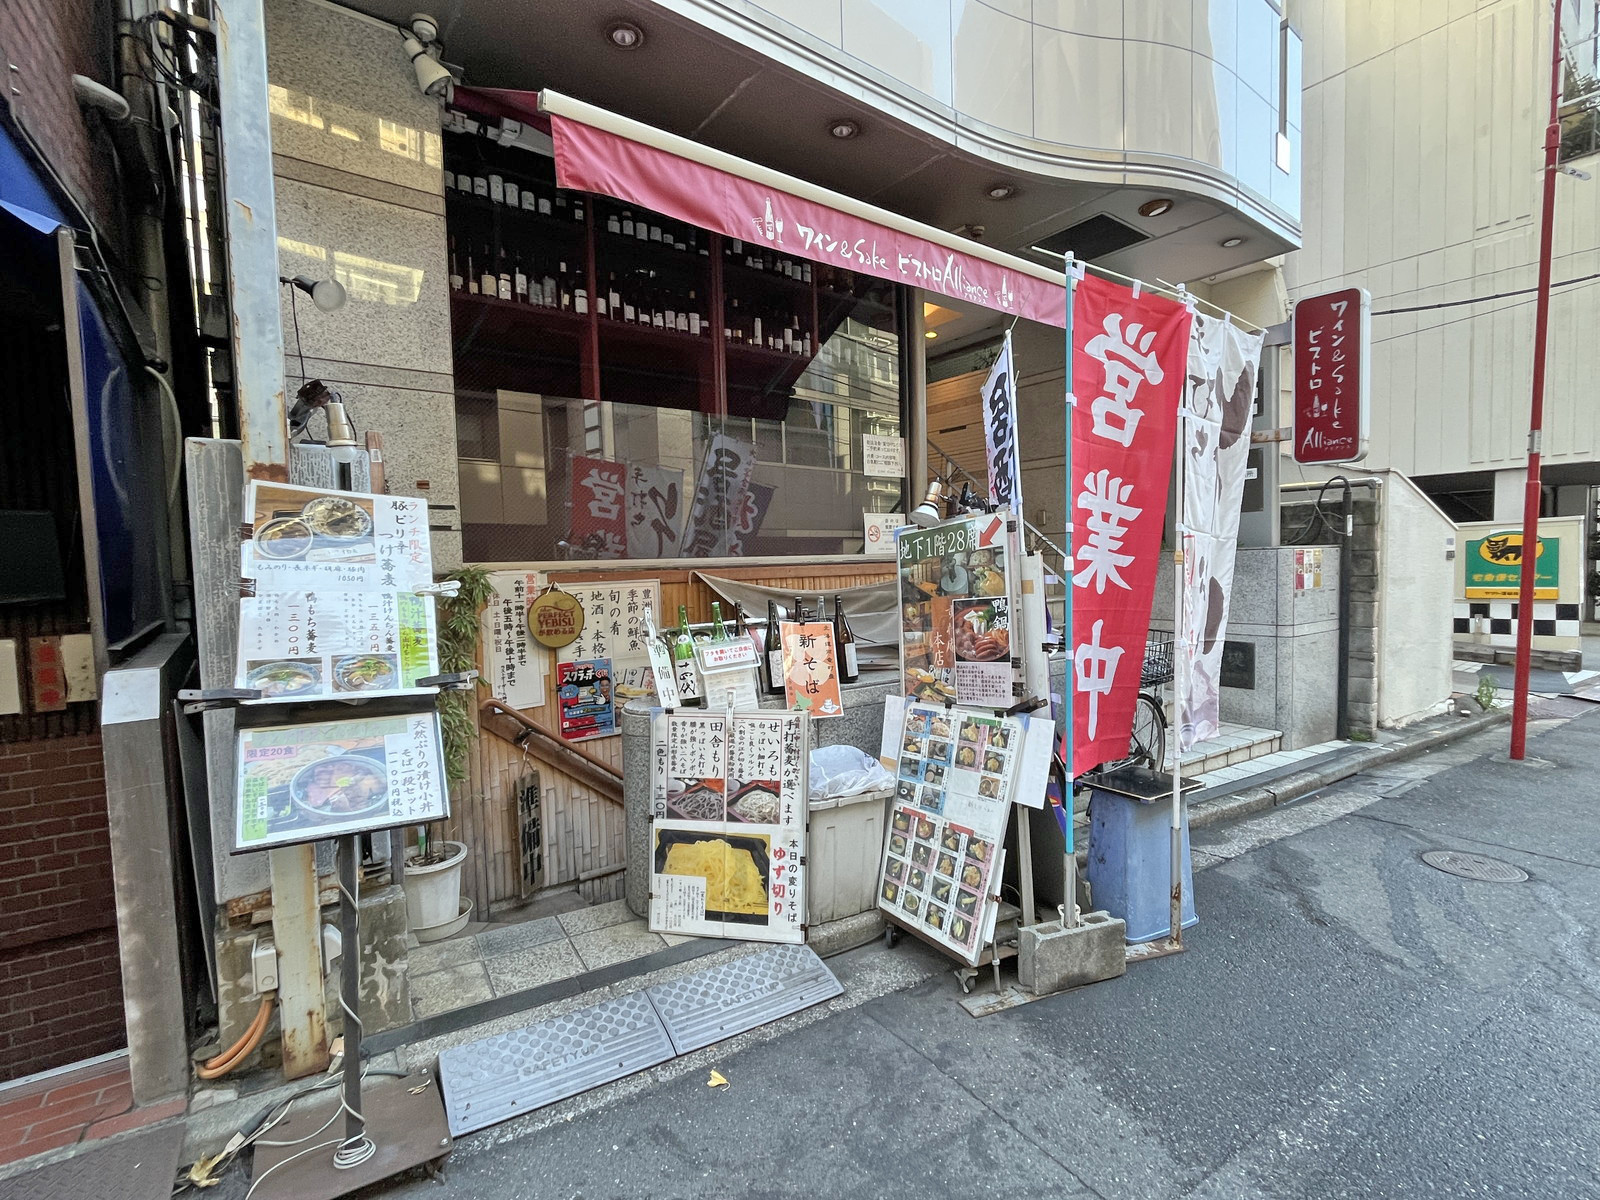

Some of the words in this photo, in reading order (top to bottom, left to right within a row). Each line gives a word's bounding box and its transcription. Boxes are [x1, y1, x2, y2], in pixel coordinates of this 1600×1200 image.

[1308, 325, 1326, 390] ビストロ
[1301, 426, 1354, 455] Alliance
[408, 501, 425, 564] ランチ限定
[899, 524, 979, 561] 地下1階28席
[337, 575, 365, 583] 1050円
[378, 532, 398, 587] つけ蕎麦
[304, 592, 319, 654] 鴨もち蕎麦
[537, 610, 576, 619] PERFECT
[537, 617, 576, 629] YEBISU
[590, 591, 607, 659] 地酒・本格
[608, 590, 622, 636] 旬の肴
[626, 589, 641, 652] 季節の鮮魚
[991, 597, 1009, 630] 鴨鍋
[713, 652, 748, 662] お取りください
[799, 634, 820, 694] 新そば
[932, 631, 946, 667] 本店
[678, 662, 696, 695] 十四代
[246, 745, 296, 759] 限定20食
[709, 722, 724, 778] 田舎もり
[519, 784, 543, 886] 準備中
[771, 846, 786, 916] ゆず切り
[787, 839, 799, 923] 本日の変りそば
